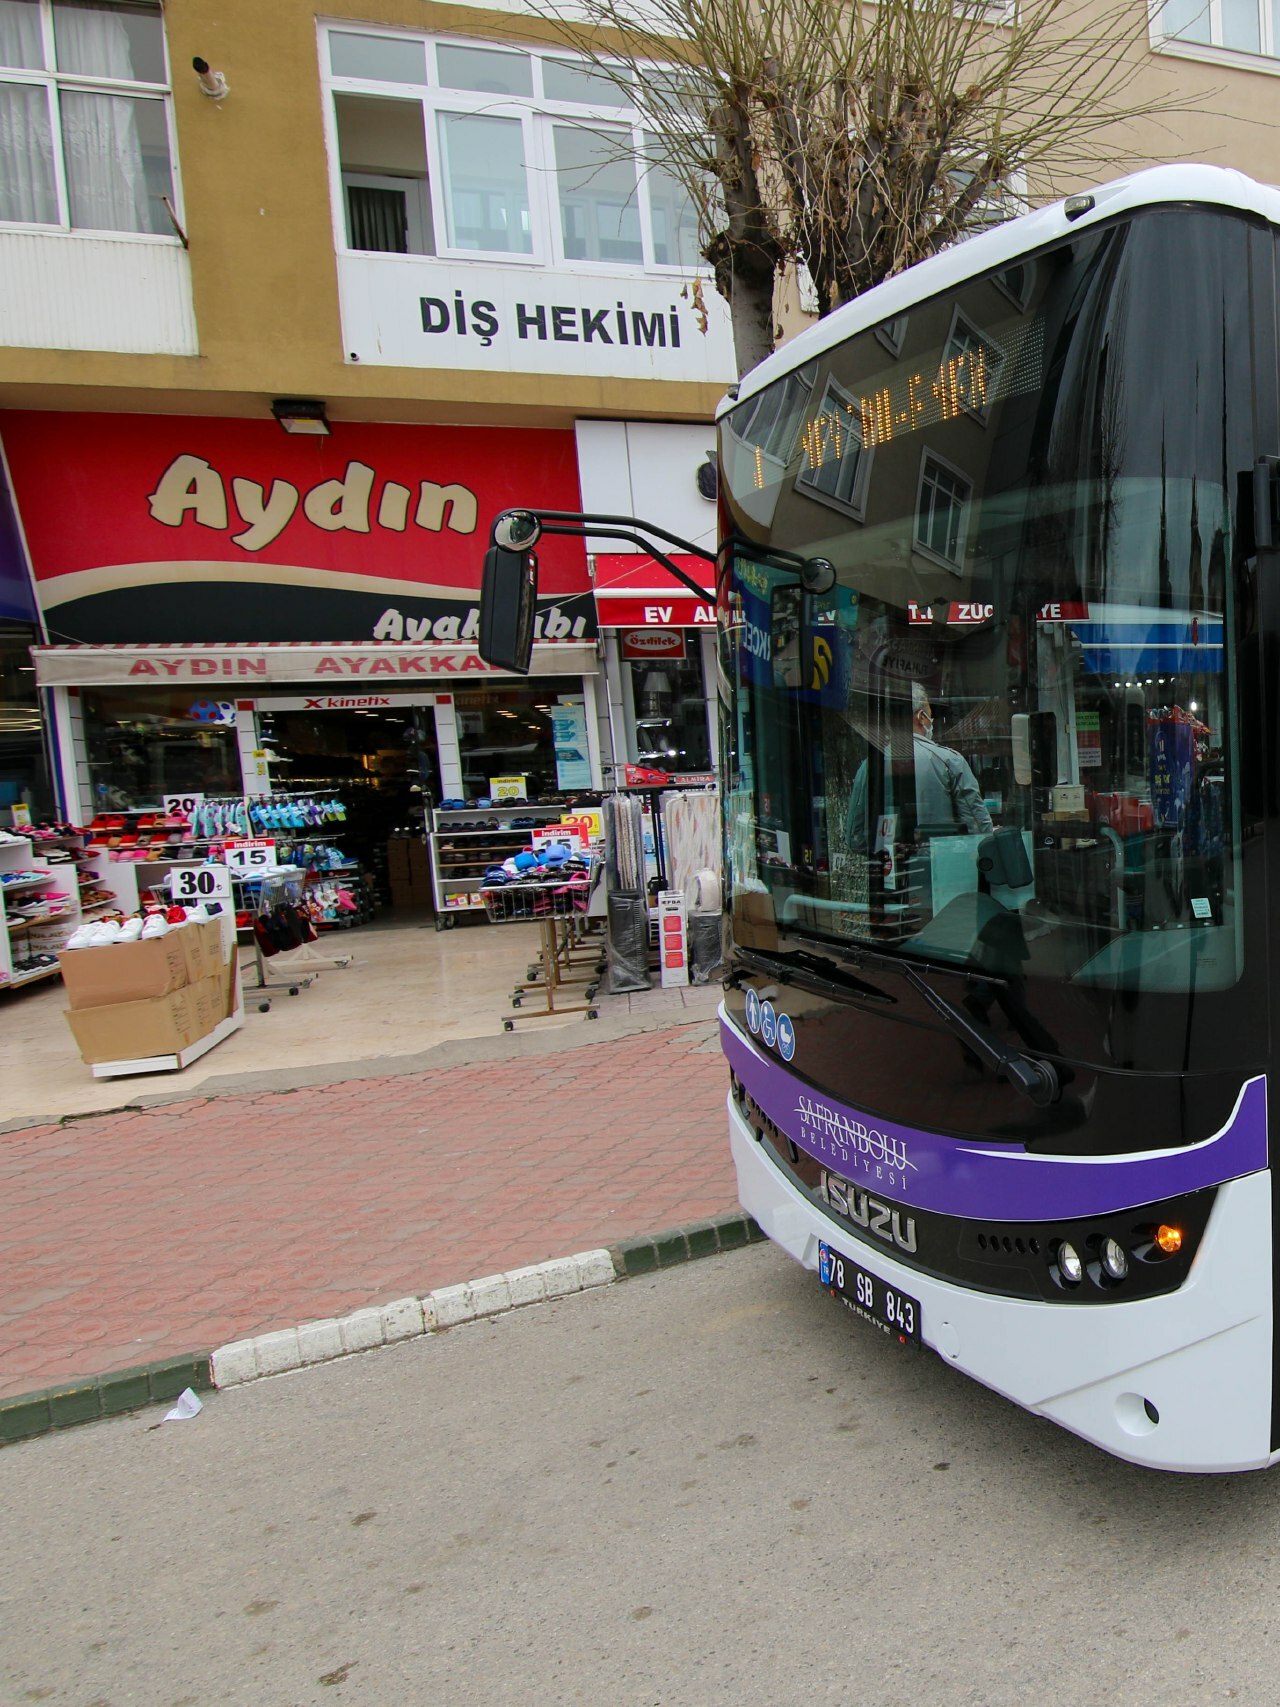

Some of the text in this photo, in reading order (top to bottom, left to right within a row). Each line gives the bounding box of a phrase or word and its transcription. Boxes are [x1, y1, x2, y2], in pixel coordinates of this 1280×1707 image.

[419, 289, 681, 348] DİŞ HEKİMİ
[146, 453, 478, 552] Aydın
[644, 606, 673, 623] EV
[630, 634, 676, 646] Özdilek
[128, 655, 502, 676] AYDIN AYAKKA
[327, 696, 391, 708] kinetix
[497, 786, 519, 797] 20
[167, 798, 195, 813] 20
[541, 829, 571, 837] indirim
[234, 840, 267, 849] indirim
[233, 849, 267, 865] 15
[797, 1095, 908, 1172] SAFRANBOLU
[800, 1126, 907, 1191] BELEDİYESİ
[820, 1170, 917, 1253] ISUZU
[829, 1253, 914, 1334] 78 SB 843
